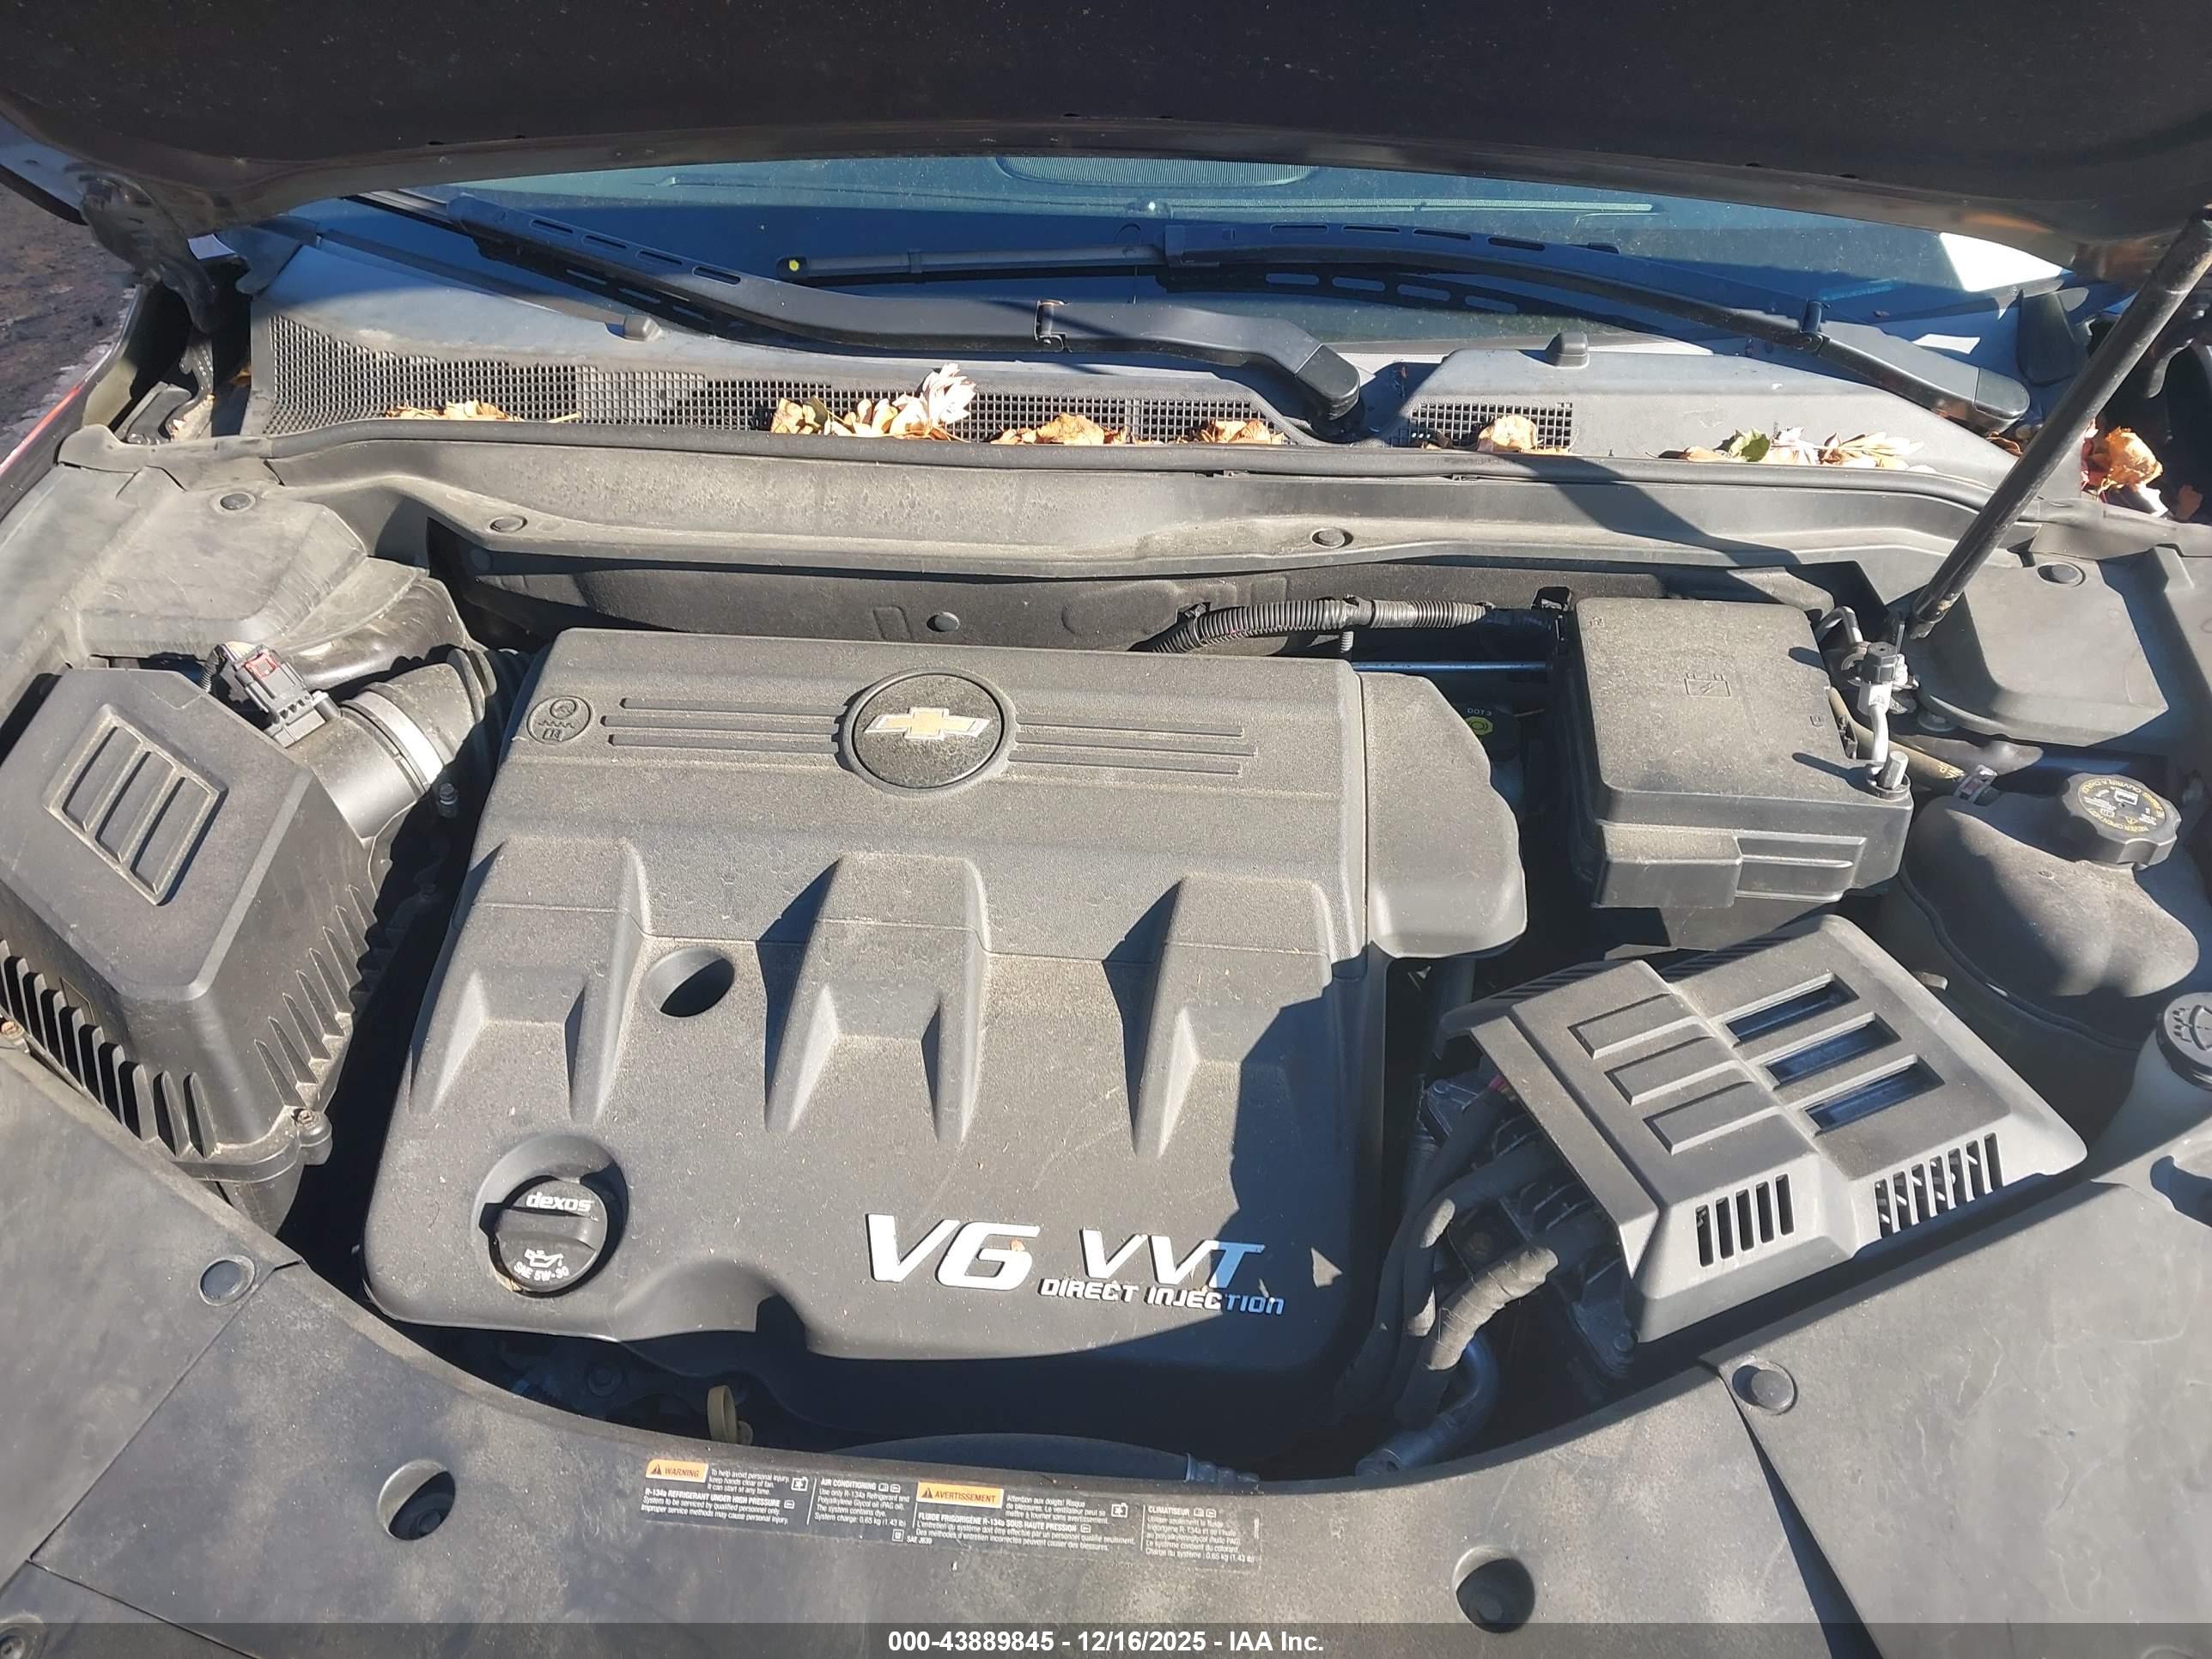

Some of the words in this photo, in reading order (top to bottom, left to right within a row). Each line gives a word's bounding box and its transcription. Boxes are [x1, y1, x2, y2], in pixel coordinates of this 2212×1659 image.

[526, 1192, 595, 1212] dexos
[866, 1213, 1041, 1290] V6
[1079, 1228, 1266, 1288] VVT
[514, 1261, 532, 1279] SAE
[534, 1266, 569, 1281] 5W-30
[1037, 1278, 1139, 1303] DIRECT
[665, 1467, 700, 1477] WARNING
[833, 1480, 876, 1490] CONDITIONING
[643, 1496, 664, 1504] System
[680, 1499, 704, 1508] serviced
[714, 1503, 738, 1511] qualified
[738, 1505, 767, 1514] personnel
[645, 1488, 666, 1497] R-134a
[668, 1490, 709, 1500] REFRIGERANT
[711, 1494, 731, 1503] UNDER
[749, 1497, 781, 1507] PRESSURE
[934, 1491, 996, 1504] AVERTISSEMENT
[1007, 1495, 1032, 1504] Attention
[641, 1504, 666, 1513] Improper
[690, 1509, 714, 1517] methods
[746, 1514, 770, 1522] personal
[815, 1511, 836, 1521] System
[829, 1505, 848, 1514] system
[1148, 1505, 1190, 1516] CLIMATISEUR
[918, 1512, 940, 1521] FLUIDE
[1024, 1521, 1044, 1529] HAUTE
[1046, 1522, 1077, 1533] PRESSION
